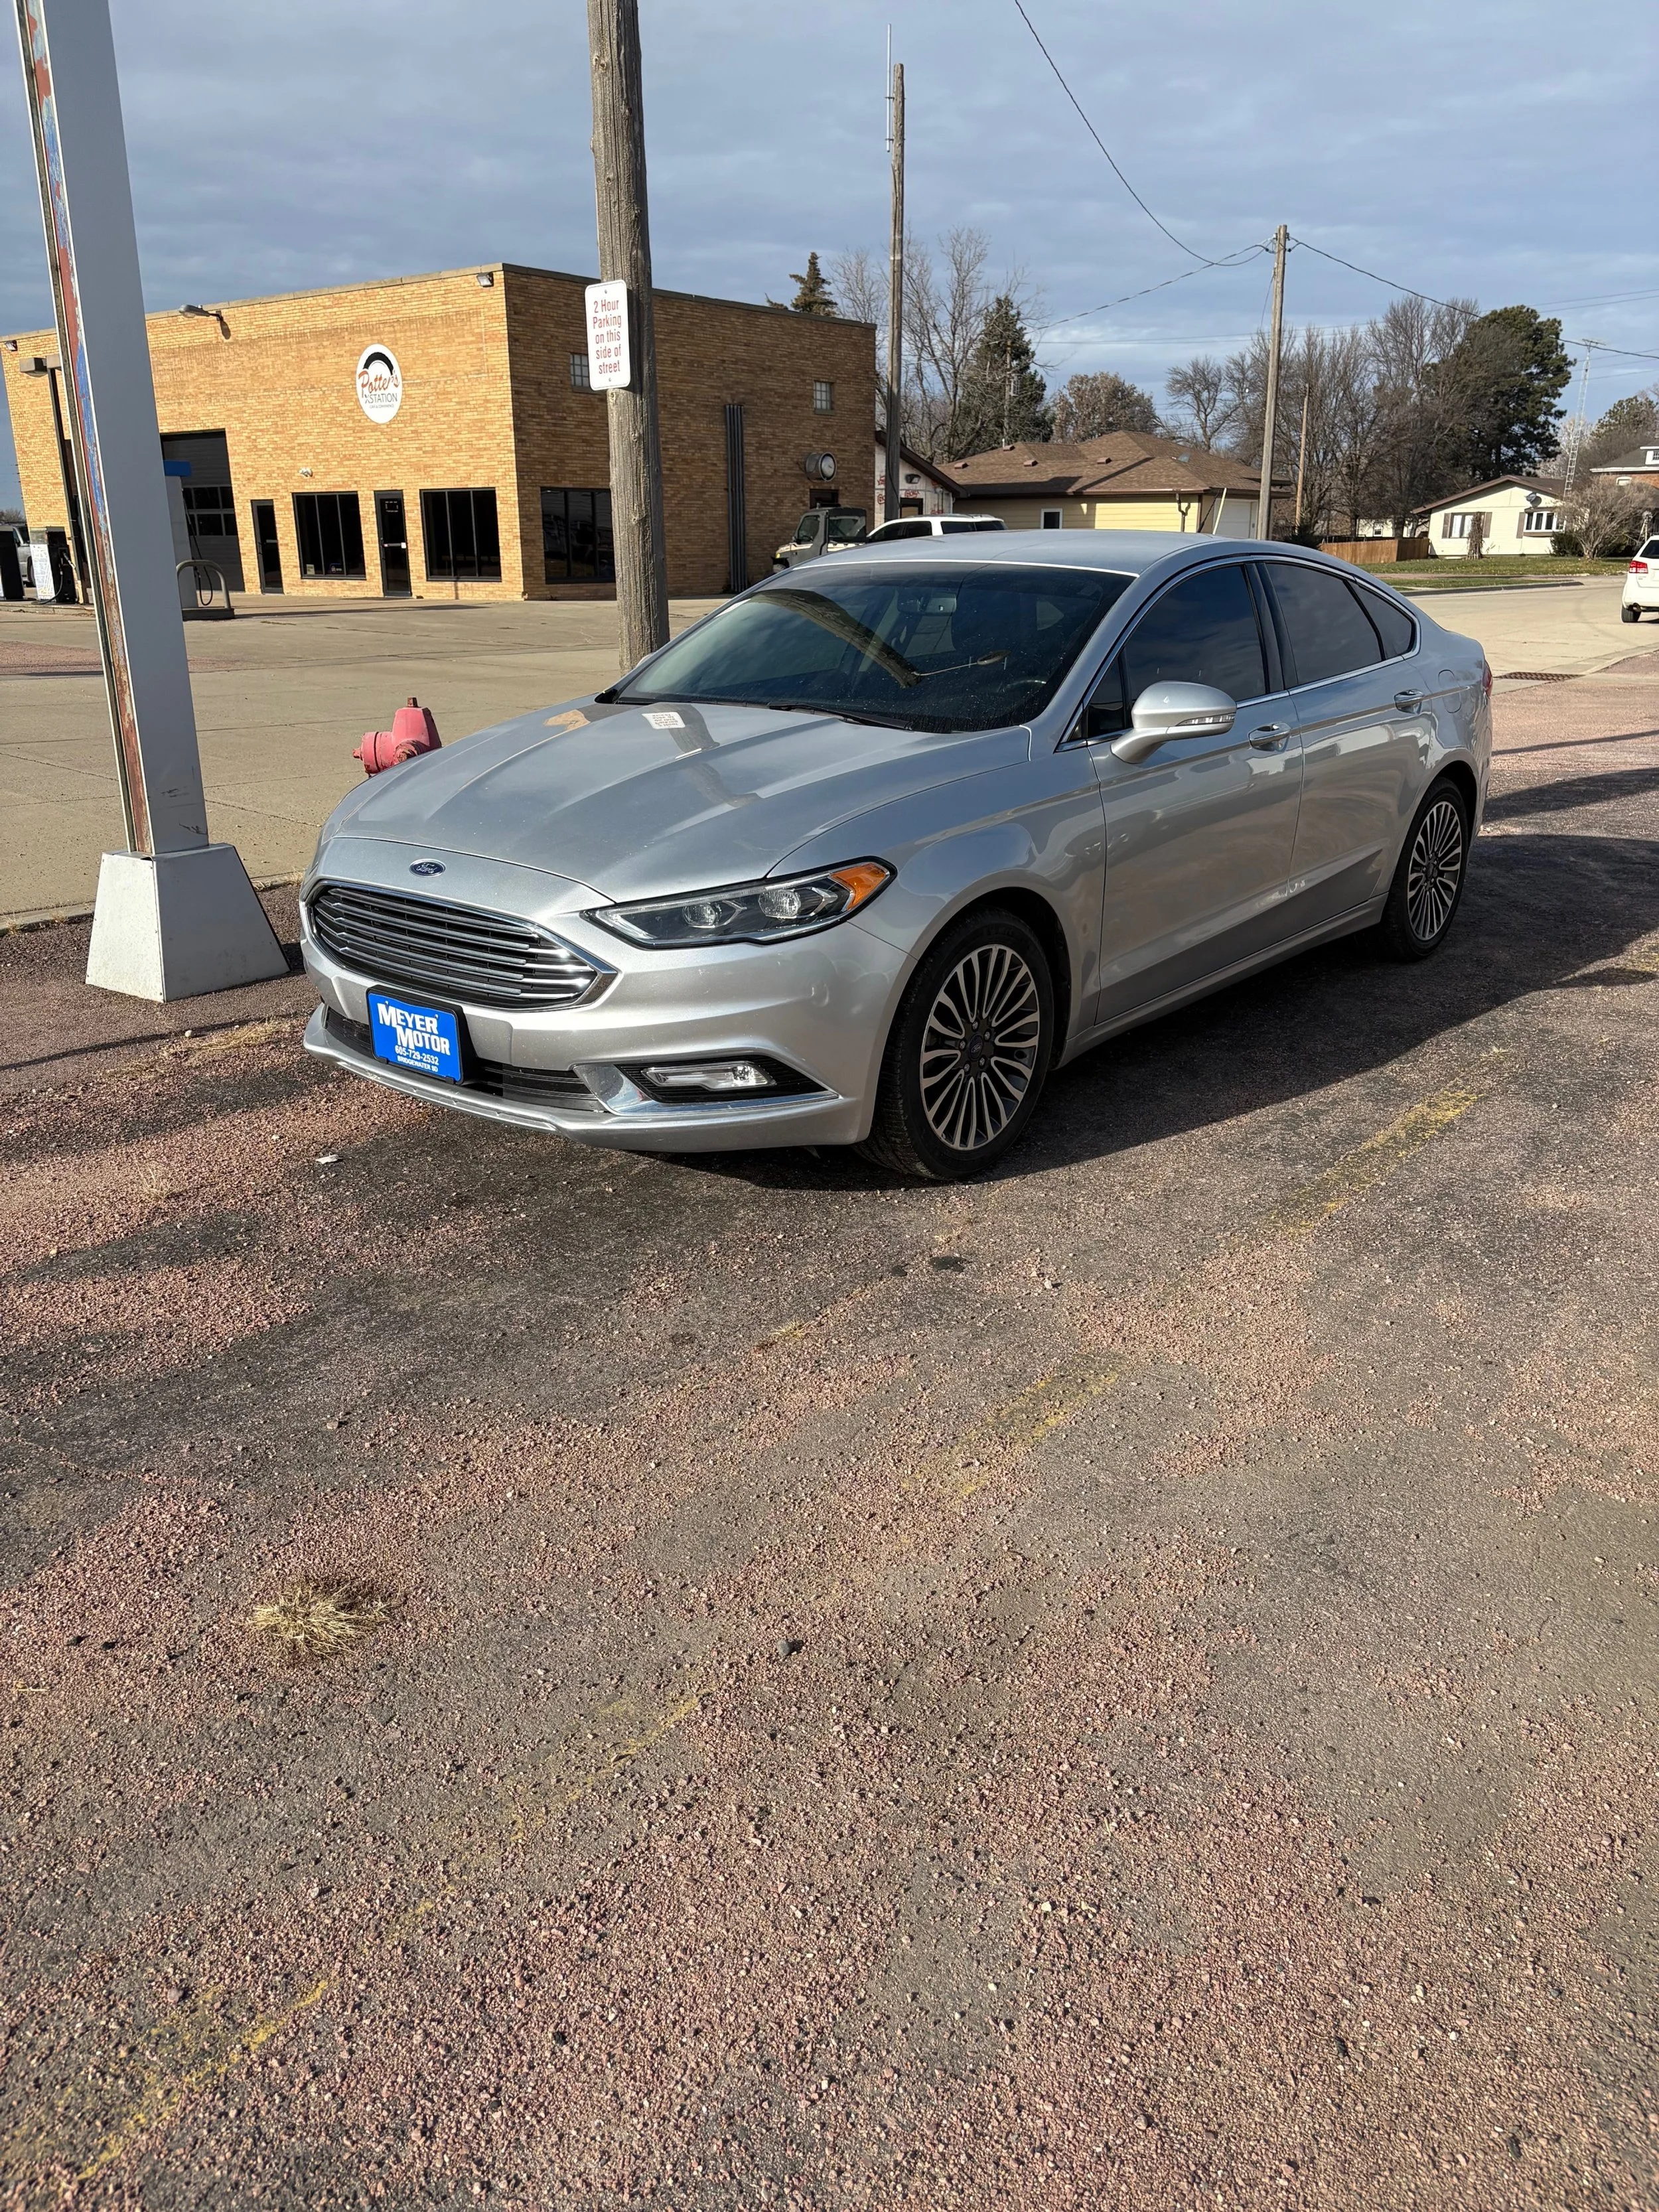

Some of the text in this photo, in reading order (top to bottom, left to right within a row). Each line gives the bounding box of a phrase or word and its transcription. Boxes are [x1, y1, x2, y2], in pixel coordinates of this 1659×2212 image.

[594, 299, 619, 313] 2 Hour
[593, 314, 622, 329] Parking
[595, 329, 620, 344] on this
[595, 344, 621, 359] side of
[599, 360, 620, 374] street
[368, 393, 397, 404] STATION
[377, 1003, 439, 1034] MEYER
[396, 1026, 451, 1055] MOTOR
[395, 1045, 439, 1065] 605-729-2532
